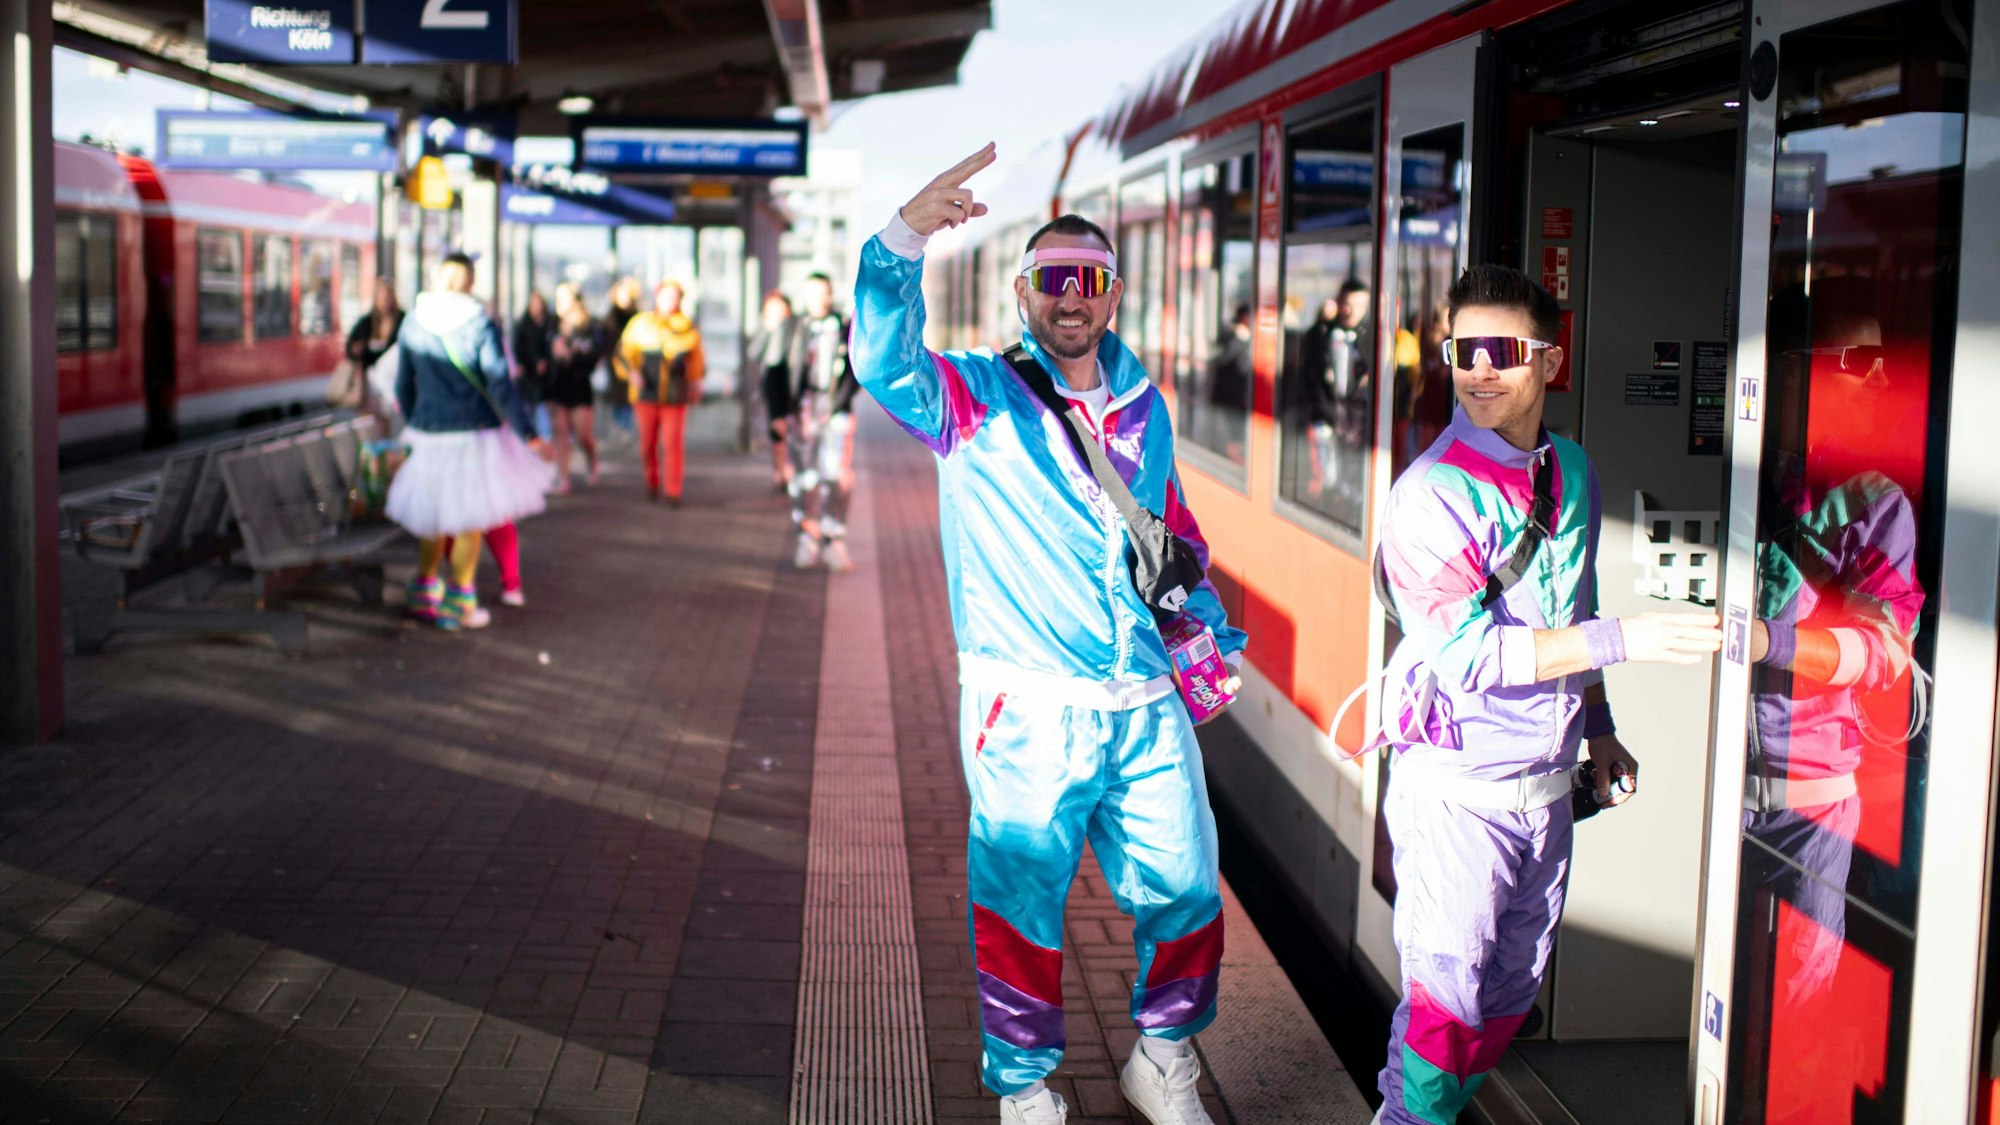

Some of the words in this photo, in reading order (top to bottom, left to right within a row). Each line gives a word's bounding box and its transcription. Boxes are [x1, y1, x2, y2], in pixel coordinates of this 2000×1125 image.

[251, 6, 330, 29] Richtung
[289, 28, 332, 50] Köln
[1265, 123, 1281, 203] 2
[1190, 675, 1222, 711] Klopfer
